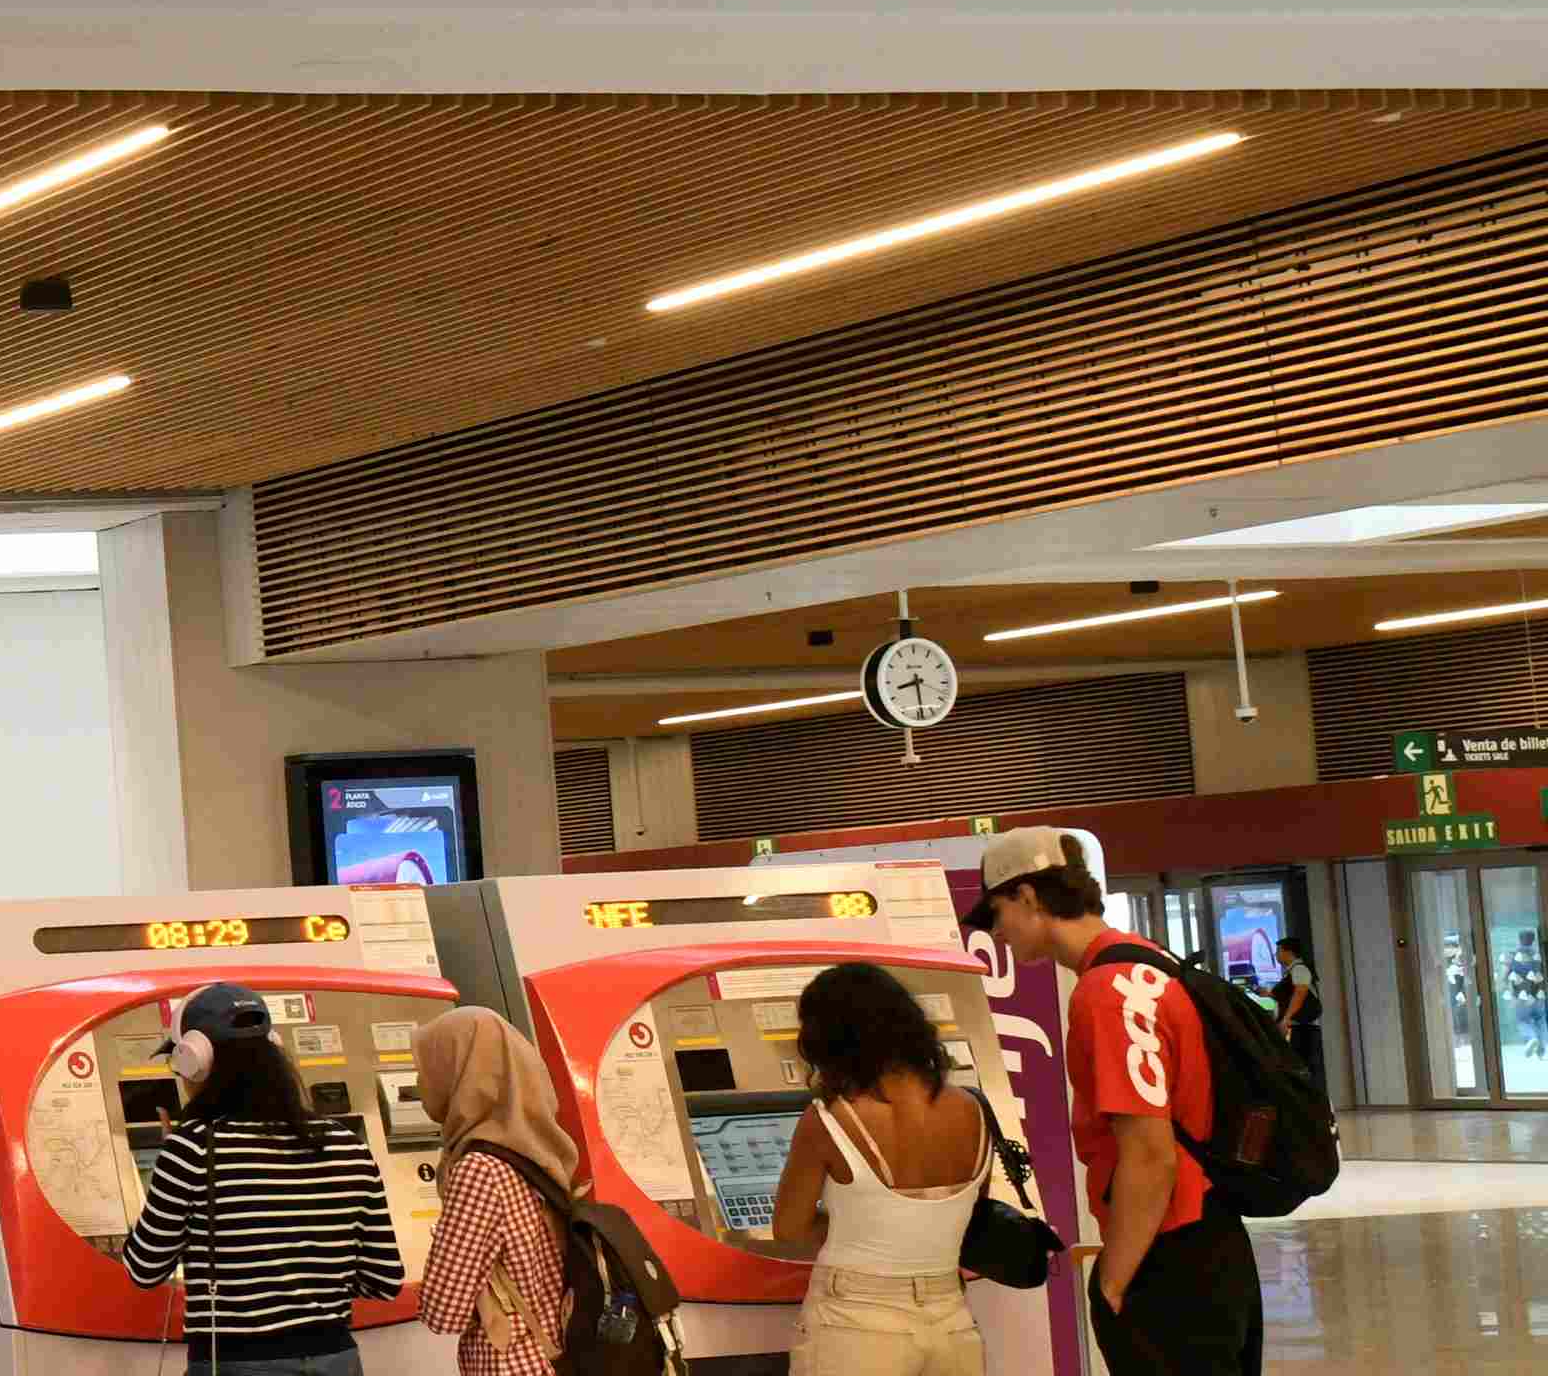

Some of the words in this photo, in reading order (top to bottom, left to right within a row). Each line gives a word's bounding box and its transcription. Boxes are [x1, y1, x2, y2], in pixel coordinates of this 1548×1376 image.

[1462, 738, 1498, 752] Venta
[1500, 737, 1517, 751] de
[327, 787, 342, 810] 2
[1385, 826, 1437, 846] SALIDA
[1444, 821, 1495, 842] EXIT
[147, 919, 250, 950] 08:29
